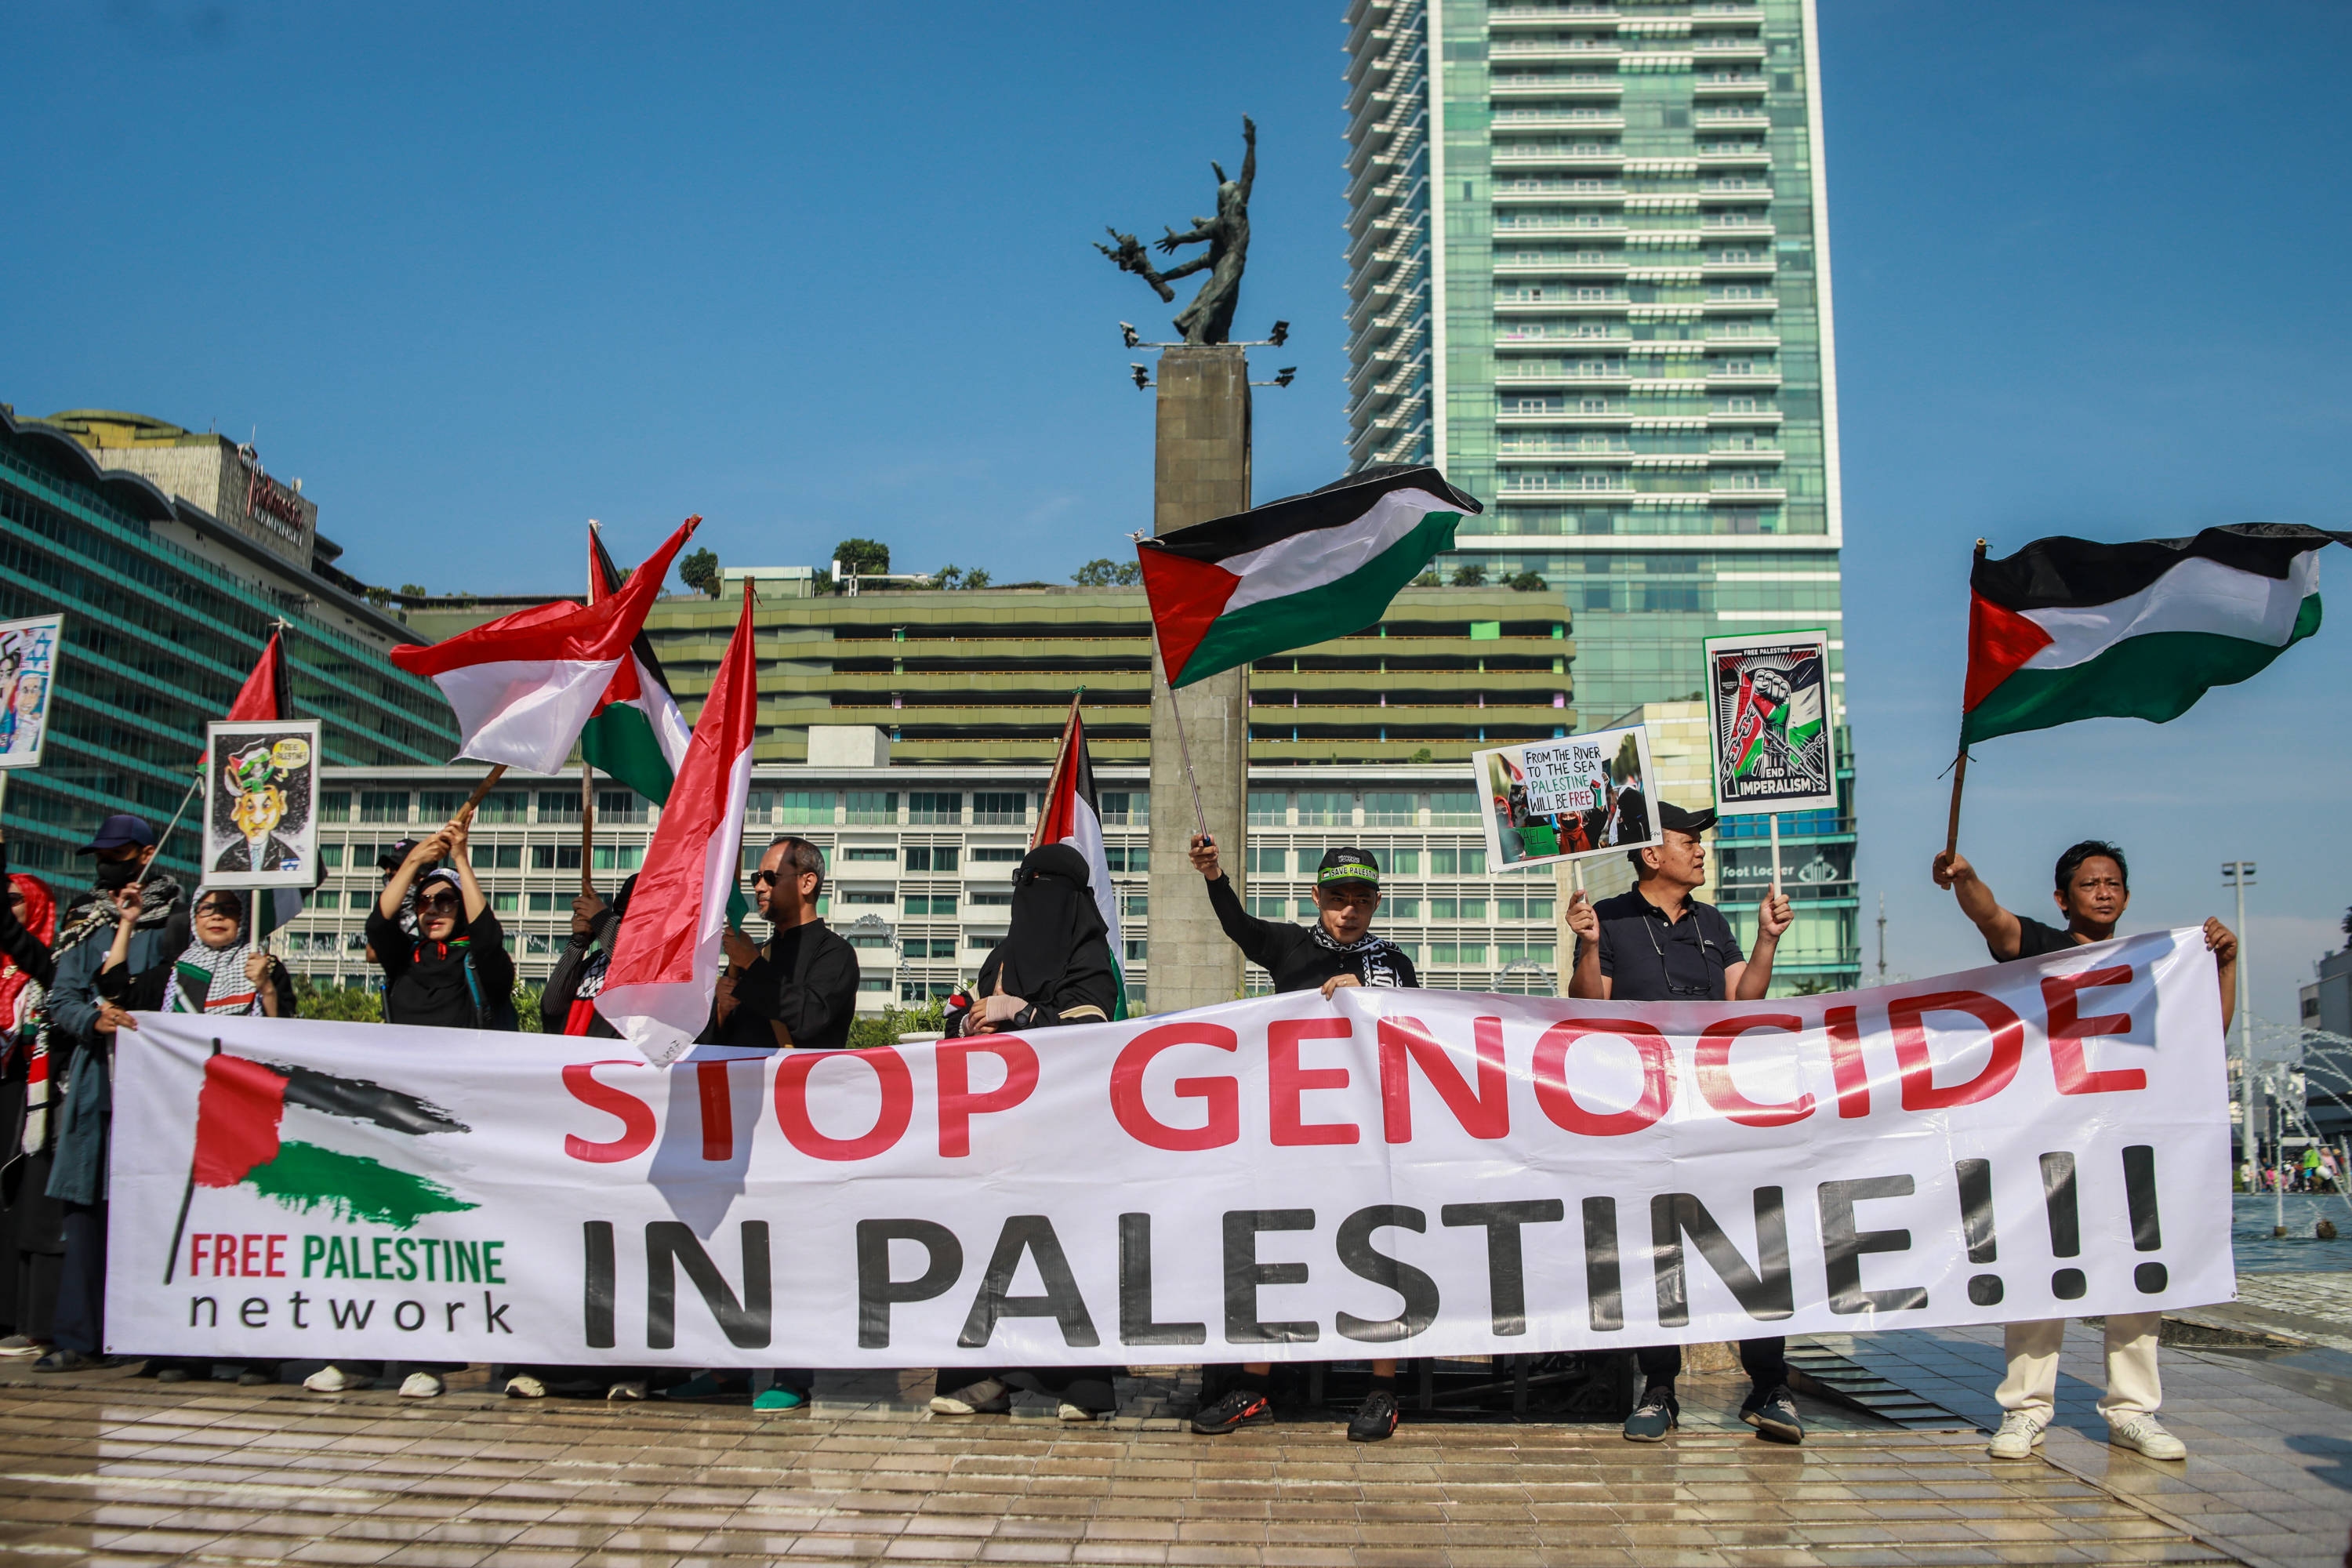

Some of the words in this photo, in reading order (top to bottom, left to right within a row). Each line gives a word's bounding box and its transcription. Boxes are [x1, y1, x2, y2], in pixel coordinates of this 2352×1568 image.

[1526, 751, 1551, 764] FROM
[1552, 749, 1570, 761] THE
[1573, 746, 1601, 760] RIVER
[1526, 766, 1541, 778] TO
[1545, 762, 1570, 776] THE
[1573, 760, 1596, 773] SEA
[1766, 768, 1785, 778] END
[1531, 775, 1590, 794] PALESTINE
[1740, 778, 1811, 796] IMPERALISM
[1530, 796, 1555, 813] WILL
[1555, 793, 1569, 810] BE
[1569, 790, 1592, 807] FREE
[1330, 867, 1348, 877] SAVE
[1722, 866, 1750, 877] Foot
[1753, 865, 1795, 877] Locer
[561, 1033, 1040, 1163] STOP
[1110, 965, 2147, 1152] GENOCIDE
[583, 1220, 772, 1349] IN
[856, 1145, 2169, 1349] PALESTINE!!!
[191, 1234, 288, 1278] FREE
[303, 1235, 506, 1284] PALESTINE
[190, 1290, 514, 1334] network
